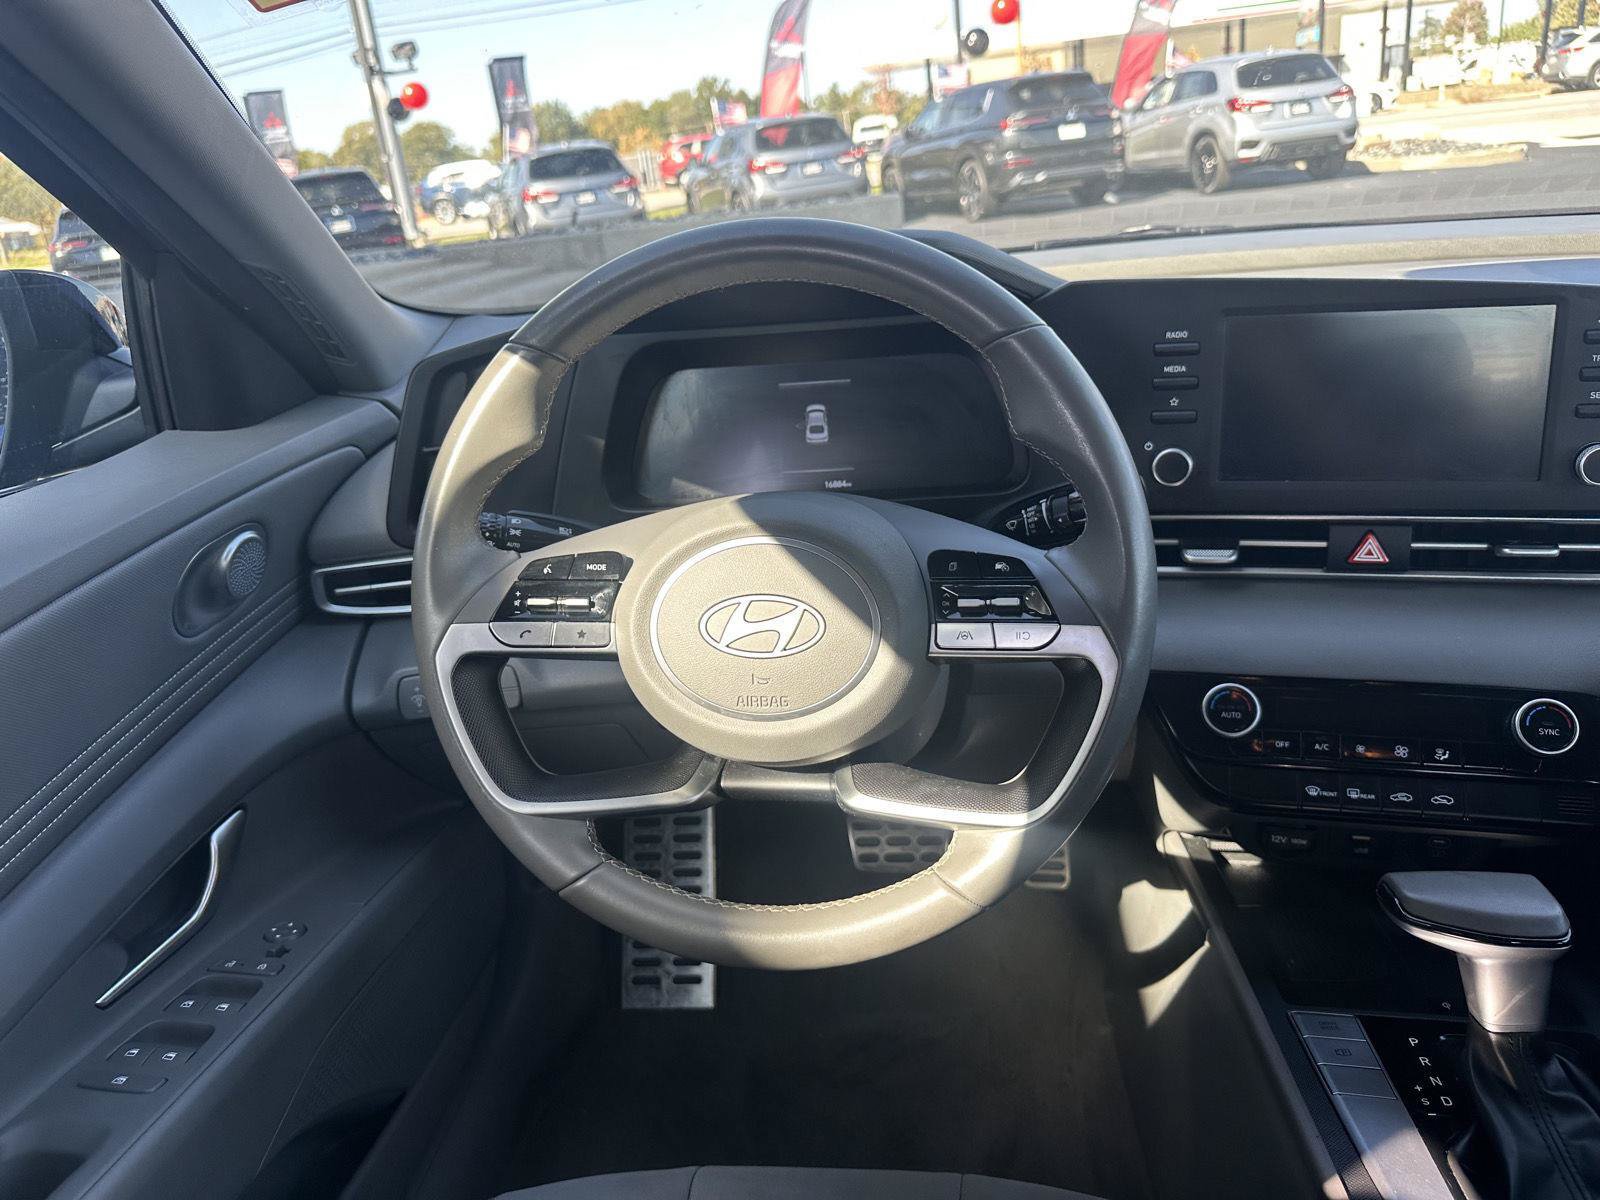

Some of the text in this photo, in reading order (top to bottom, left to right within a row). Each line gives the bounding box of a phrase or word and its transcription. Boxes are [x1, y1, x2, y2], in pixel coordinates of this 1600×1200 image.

[1165, 330, 1188, 339] RADIO
[1163, 365, 1186, 373] MEDIA
[586, 563, 607, 571] MODE
[736, 695, 789, 707] AIRBAG
[1220, 711, 1242, 719] AUTO
[1538, 727, 1561, 736] SYNC
[1274, 740, 1291, 748] OFF
[1314, 743, 1330, 751] A/C
[1319, 790, 1338, 798] FRONT
[1271, 834, 1288, 844] 12V
[1408, 1037, 1419, 1047] P
[1419, 1056, 1432, 1066] R
[1429, 1076, 1443, 1087] N
[1421, 1097, 1430, 1106] S
[1440, 1096, 1453, 1106] D
